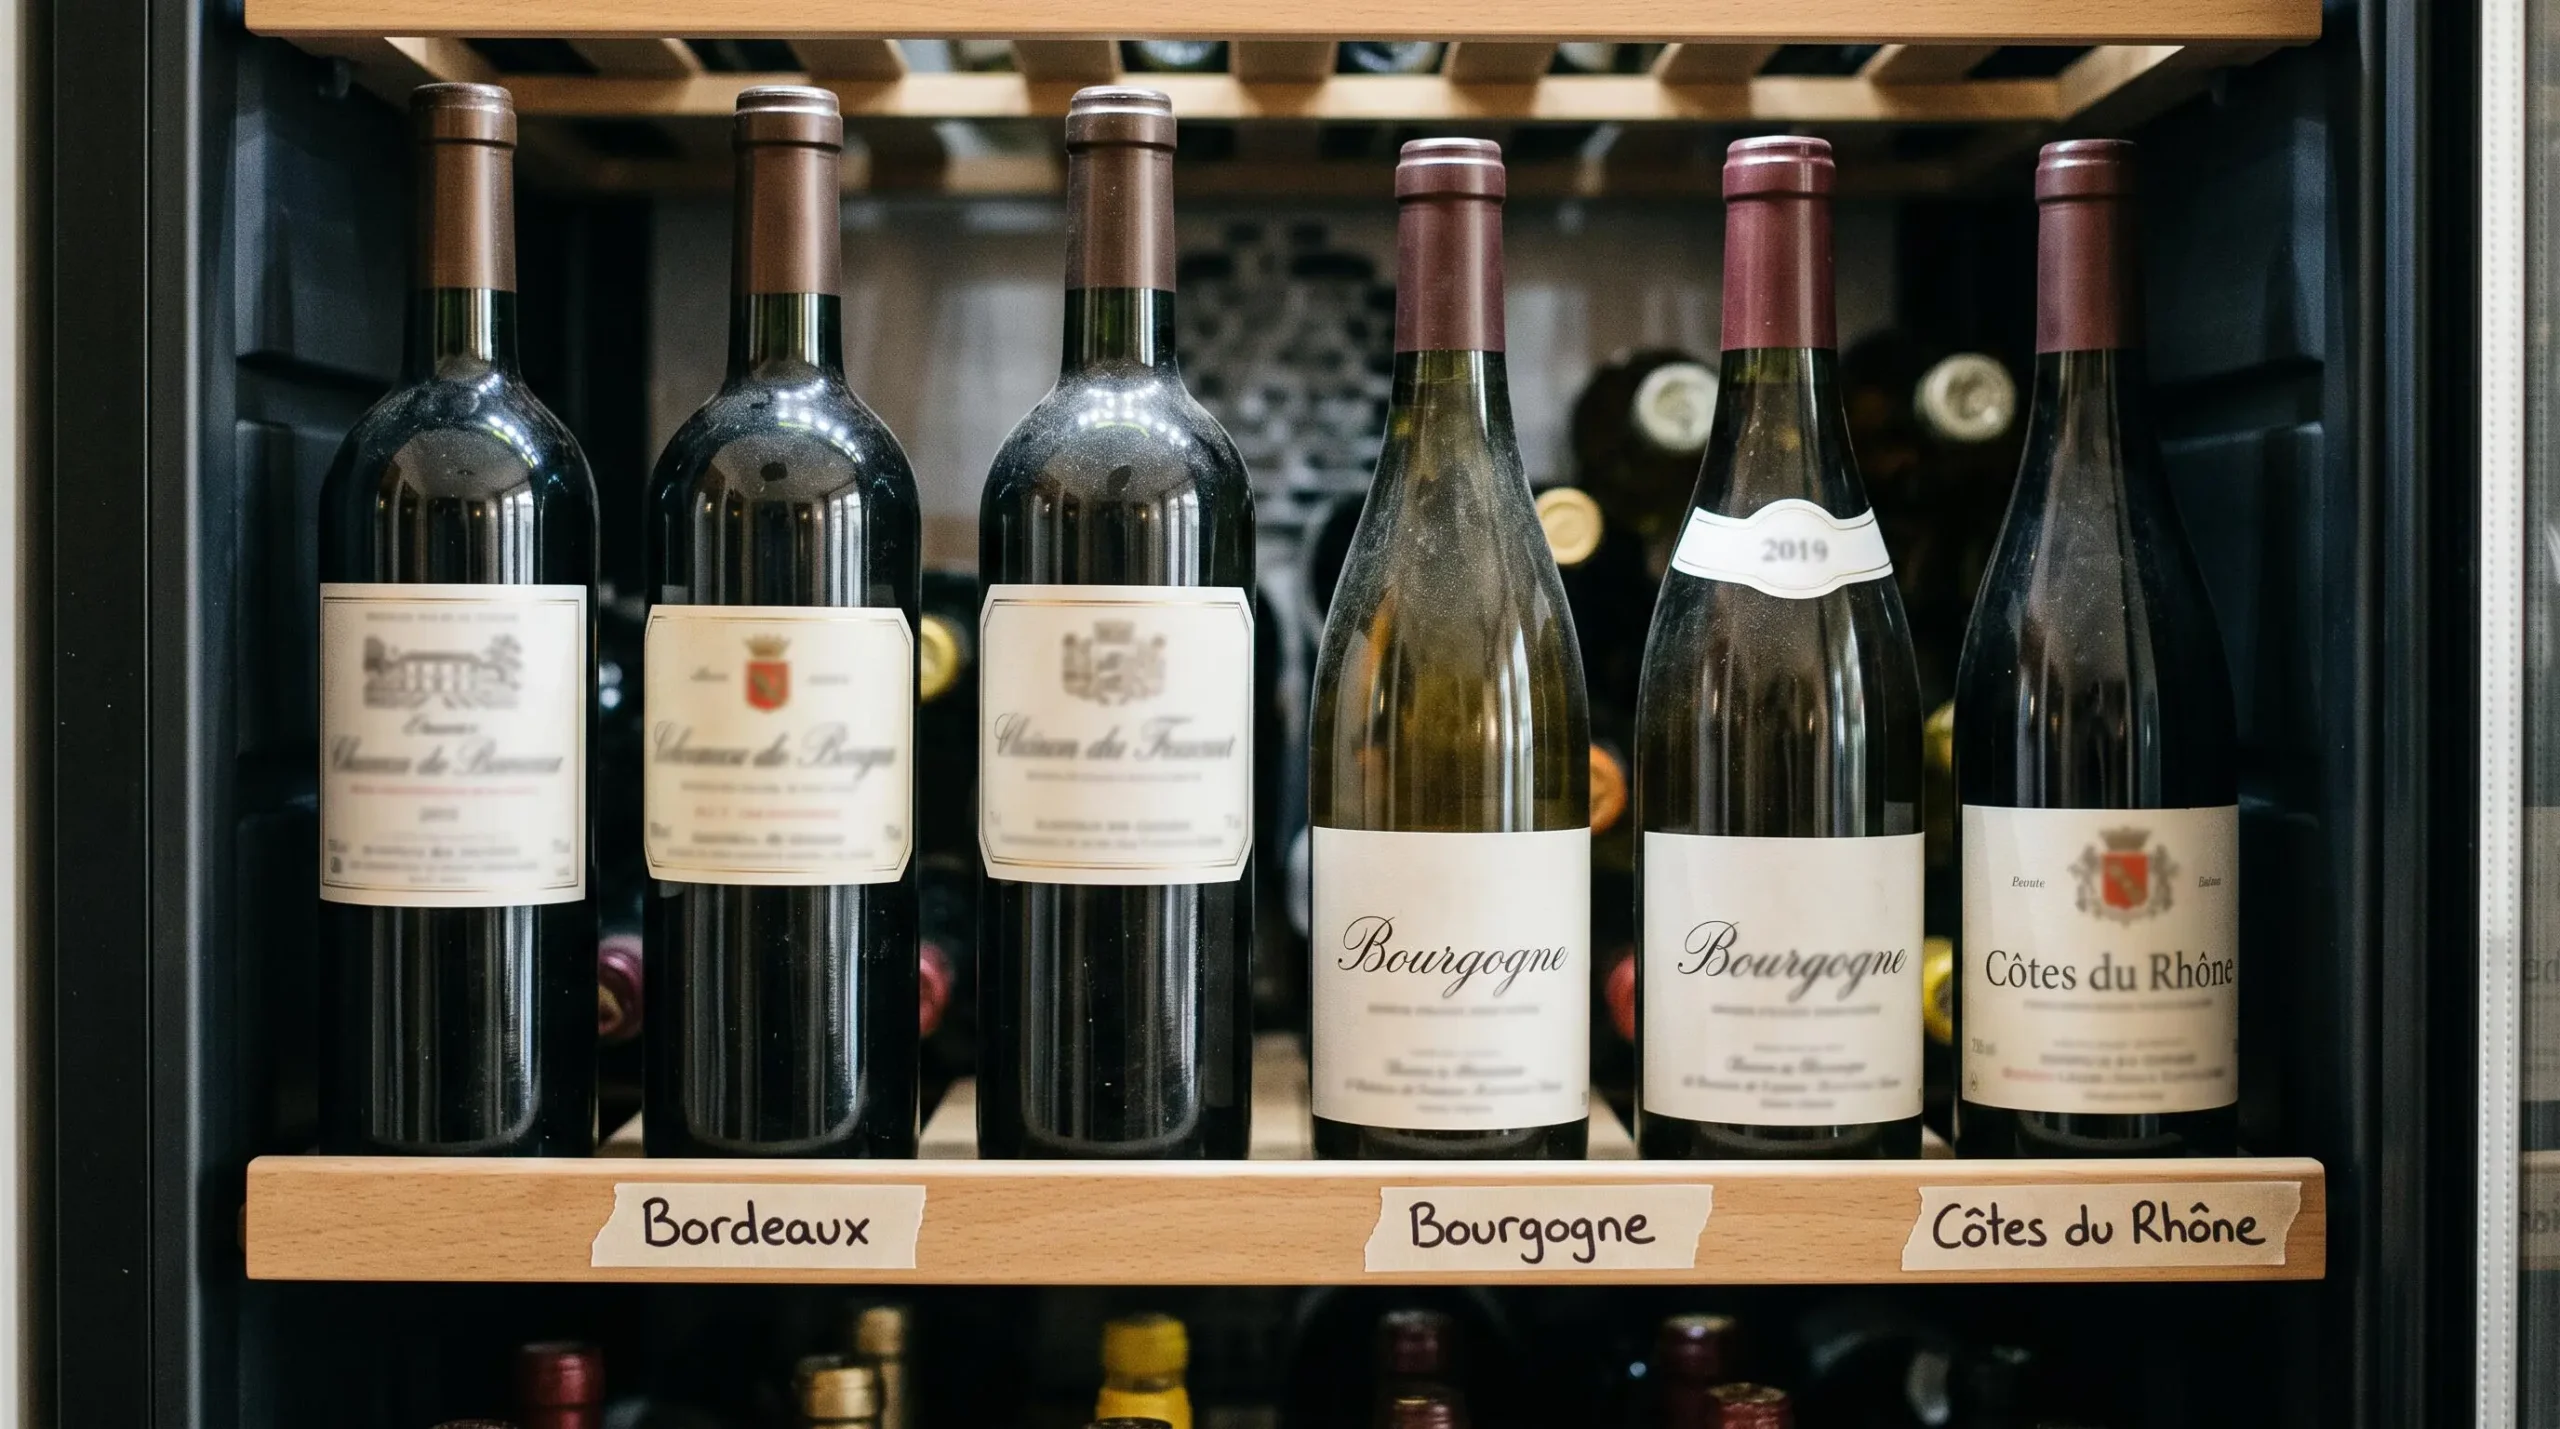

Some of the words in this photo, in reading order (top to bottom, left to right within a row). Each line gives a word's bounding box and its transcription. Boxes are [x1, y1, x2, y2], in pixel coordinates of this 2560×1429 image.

[1761, 538, 1828, 563] 2019
[1337, 915, 1568, 999] Bourgogne
[1677, 920, 1908, 1002] Bourgogne
[1986, 950, 2077, 990] Côtes
[2089, 952, 2137, 992] du
[2150, 952, 2234, 992] Rhône
[642, 1197, 870, 1247] Bordeaux
[1409, 1201, 1656, 1264] Bourgogne
[1932, 1201, 2048, 1249] Côtes
[2064, 1203, 2113, 1247] du
[2132, 1200, 2266, 1245] Rhône
